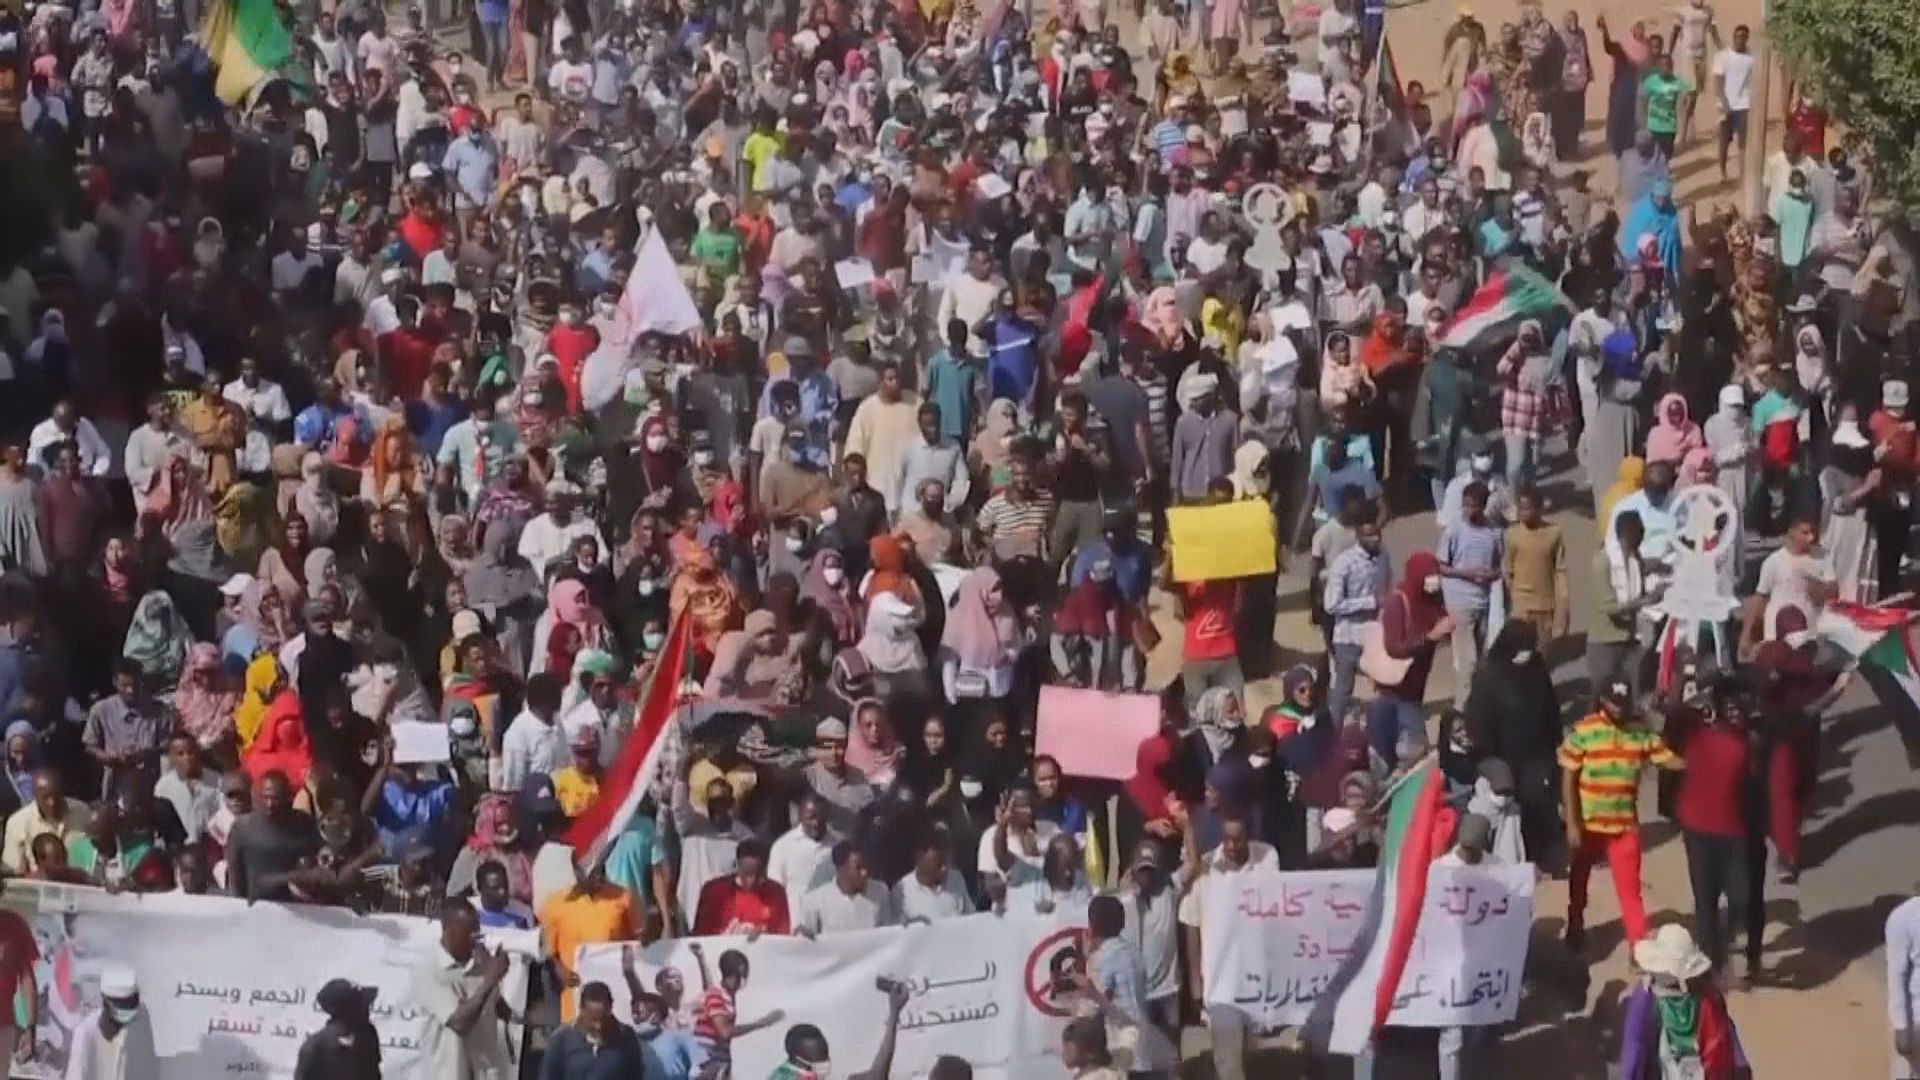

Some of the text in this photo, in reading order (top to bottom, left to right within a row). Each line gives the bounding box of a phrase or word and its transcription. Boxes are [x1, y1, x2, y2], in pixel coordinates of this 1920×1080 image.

[1237, 882, 1314, 918] كاملة
[1440, 885, 1511, 926] دولة
[249, 986, 306, 1008] الجمع
